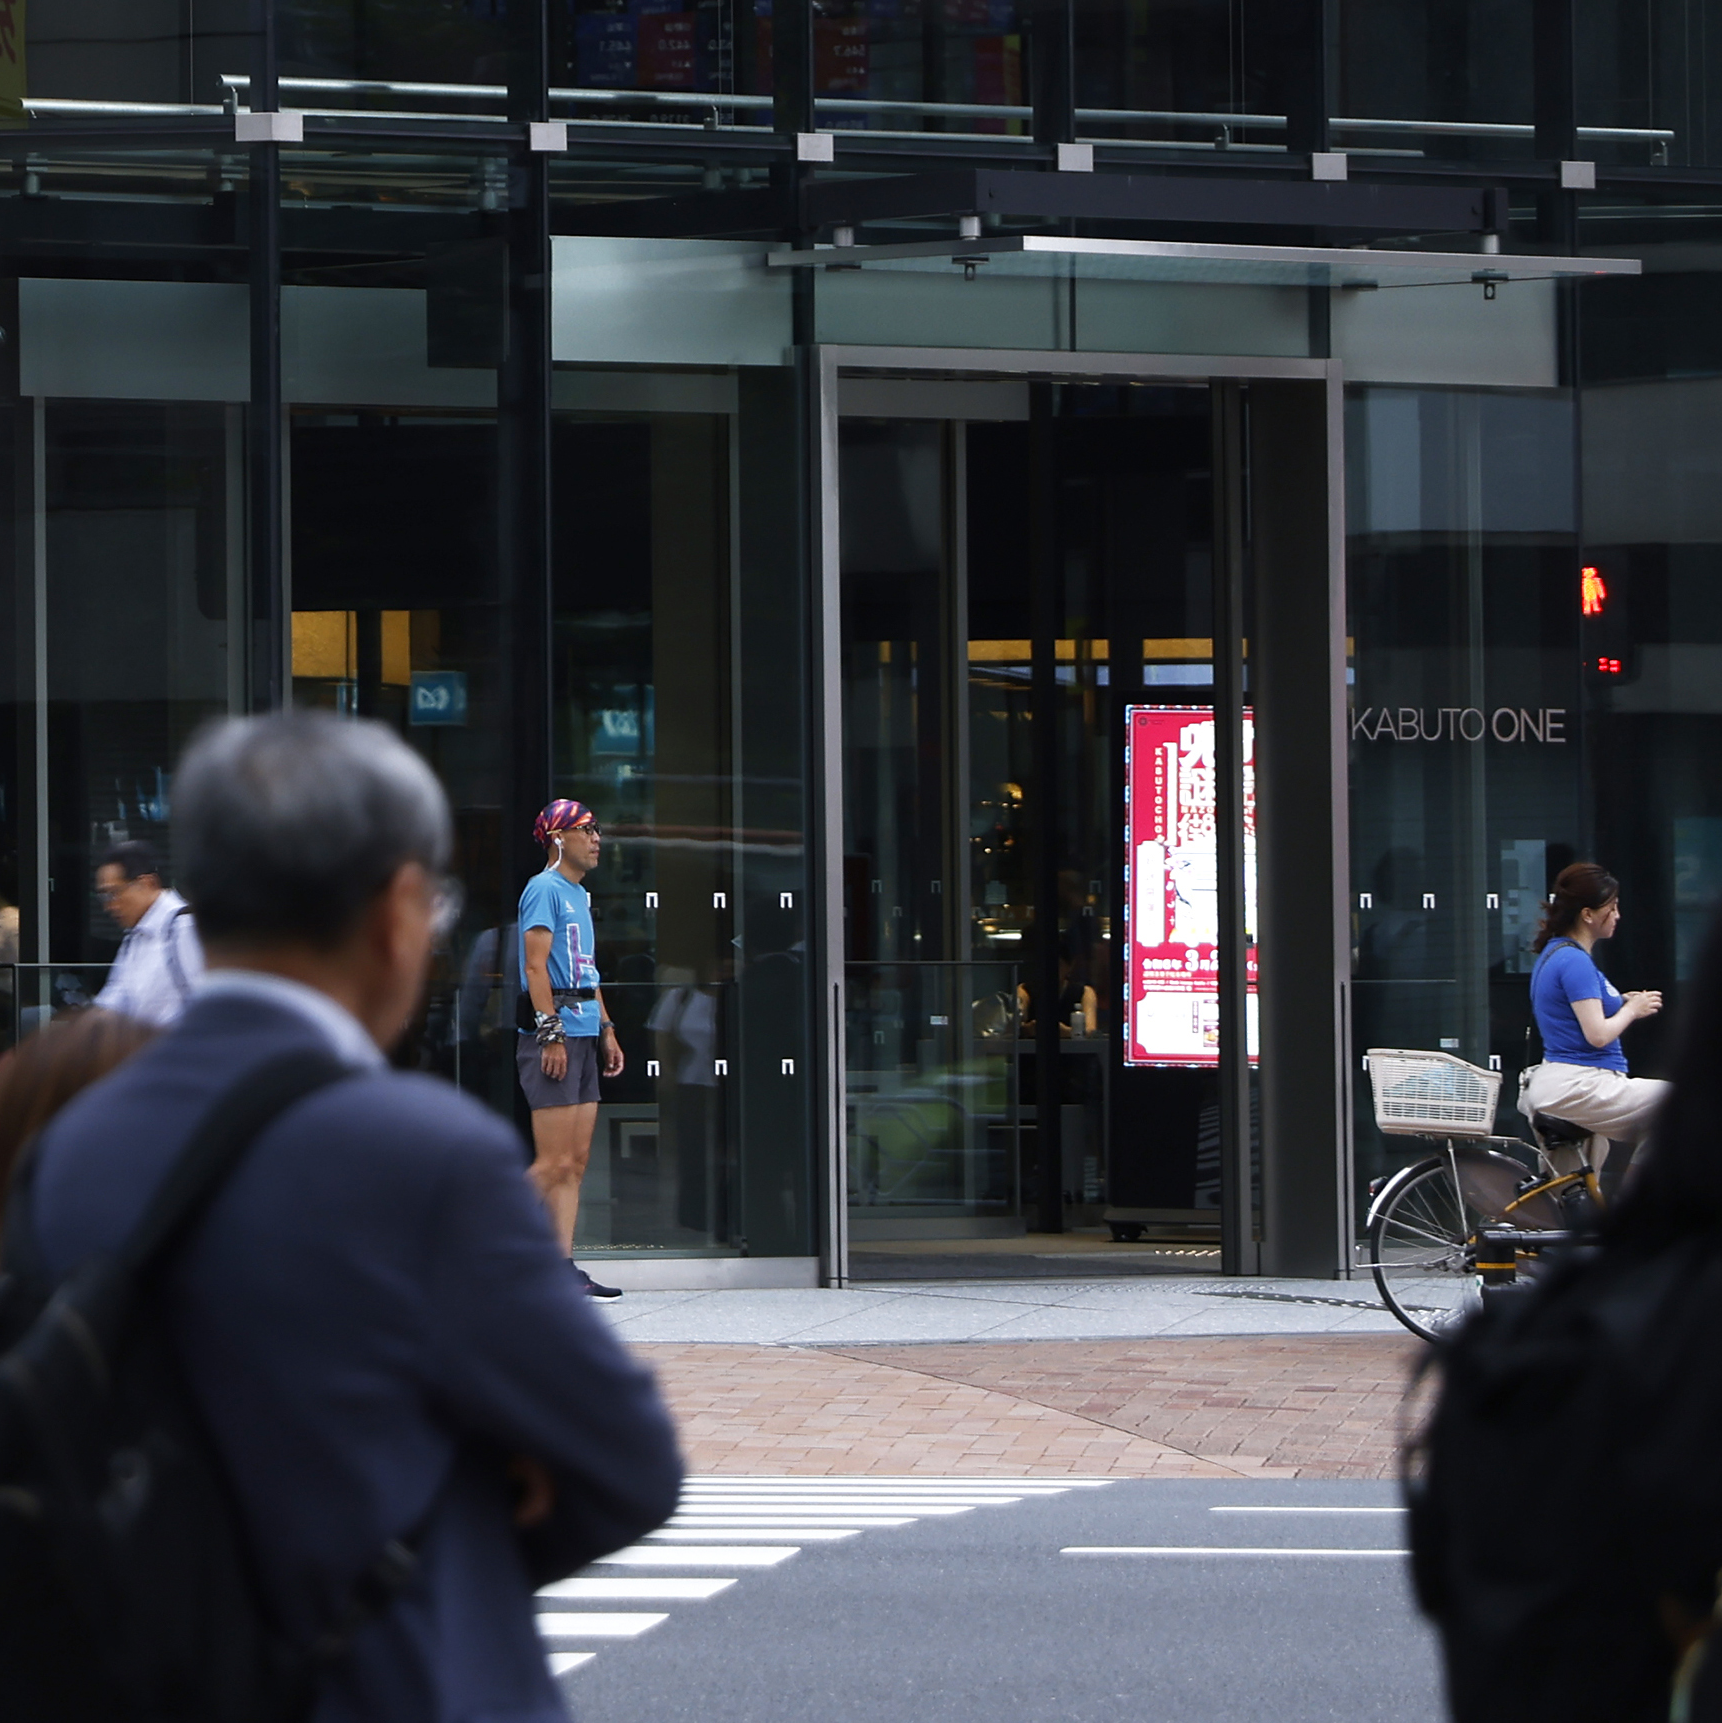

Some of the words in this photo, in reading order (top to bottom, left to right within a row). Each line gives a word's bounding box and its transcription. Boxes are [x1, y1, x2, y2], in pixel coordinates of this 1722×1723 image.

[1351, 707, 1486, 741] KABUTO
[1492, 707, 1566, 743] ONE
[1154, 747, 1163, 833] KABUTOCHO
